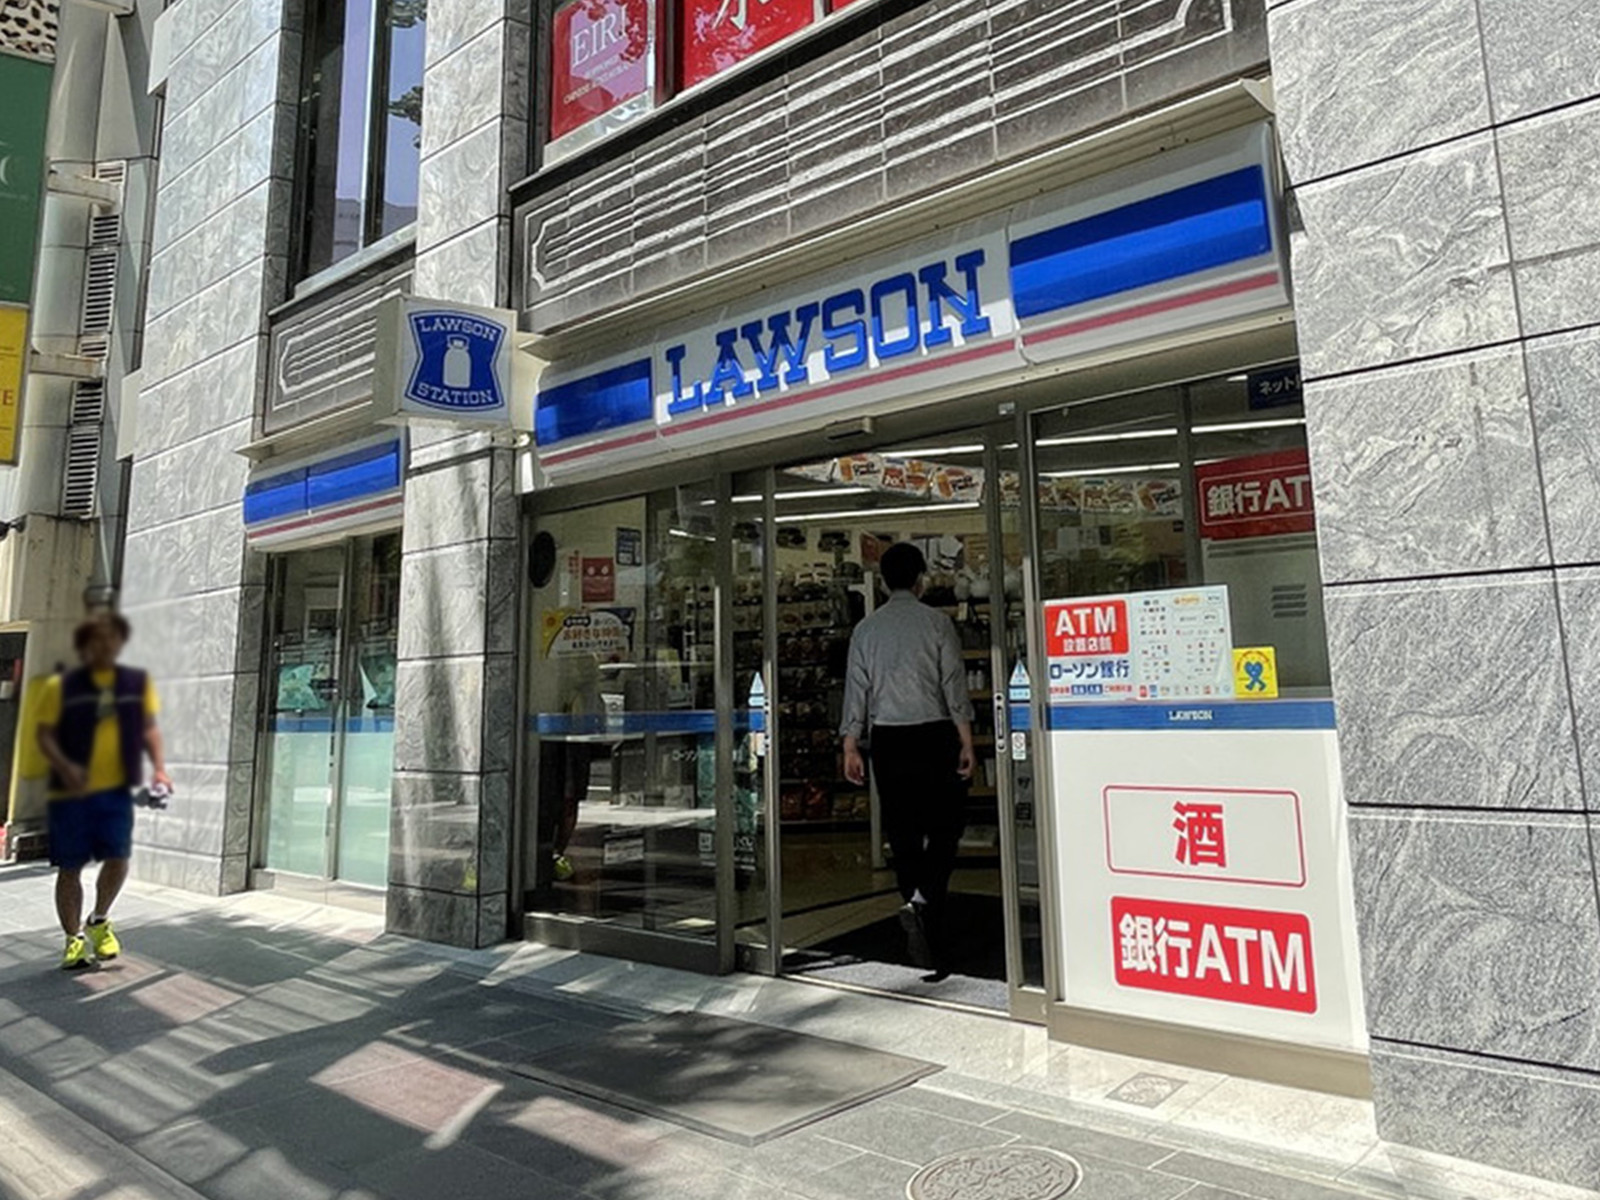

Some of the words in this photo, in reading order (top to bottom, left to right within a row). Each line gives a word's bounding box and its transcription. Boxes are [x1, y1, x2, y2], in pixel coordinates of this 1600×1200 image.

[418, 317, 497, 341] LAWSON
[666, 248, 991, 414] LAWSON
[416, 382, 494, 404] STATION
[1259, 374, 1300, 396] ネット
[1055, 606, 1117, 636] ATM
[1172, 801, 1226, 868] 酒
[1118, 913, 1308, 994] 銀行ATM
